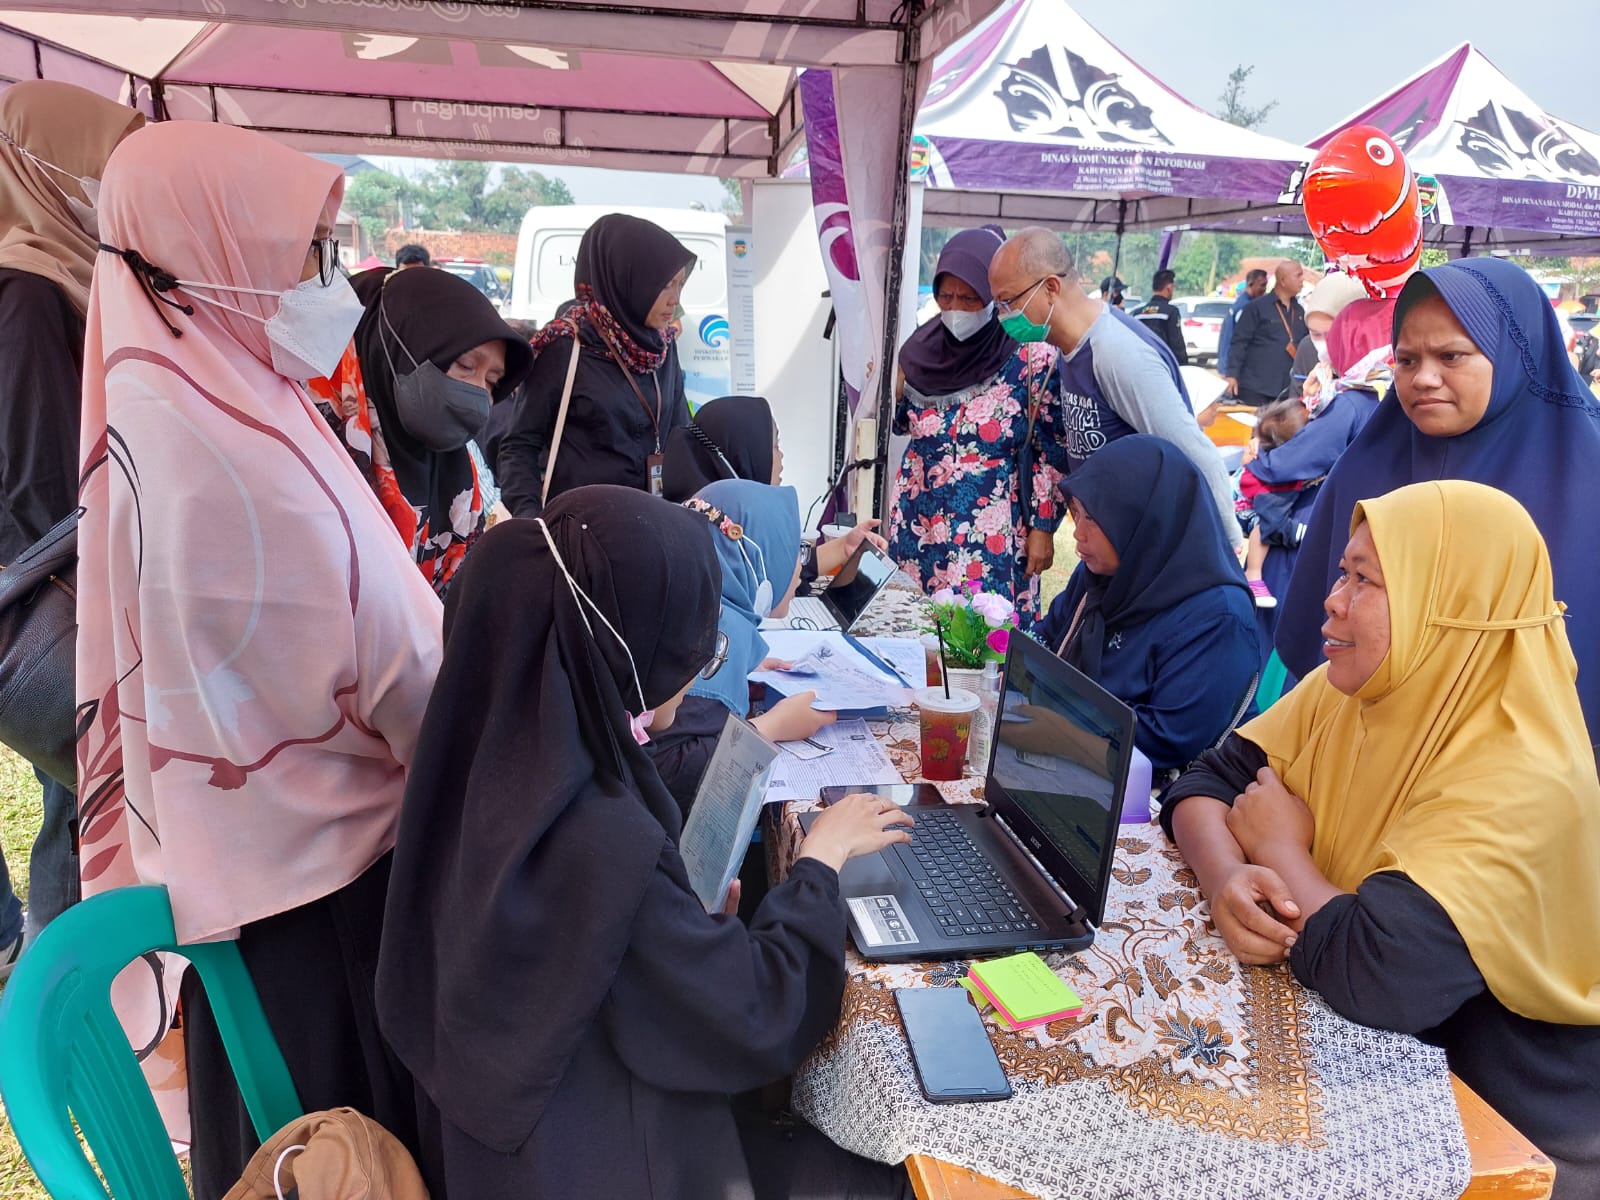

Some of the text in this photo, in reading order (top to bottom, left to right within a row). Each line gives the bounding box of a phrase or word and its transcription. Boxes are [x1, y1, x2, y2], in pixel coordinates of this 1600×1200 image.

[1041, 153, 1071, 163] DINAS
[1072, 154, 1132, 166] KOMUNIKASI
[1154, 157, 1206, 170] INFORMASI
[1078, 167, 1122, 176] KABUPATEN
[1566, 184, 1600, 200] DPM
[1502, 196, 1521, 205] DINAS
